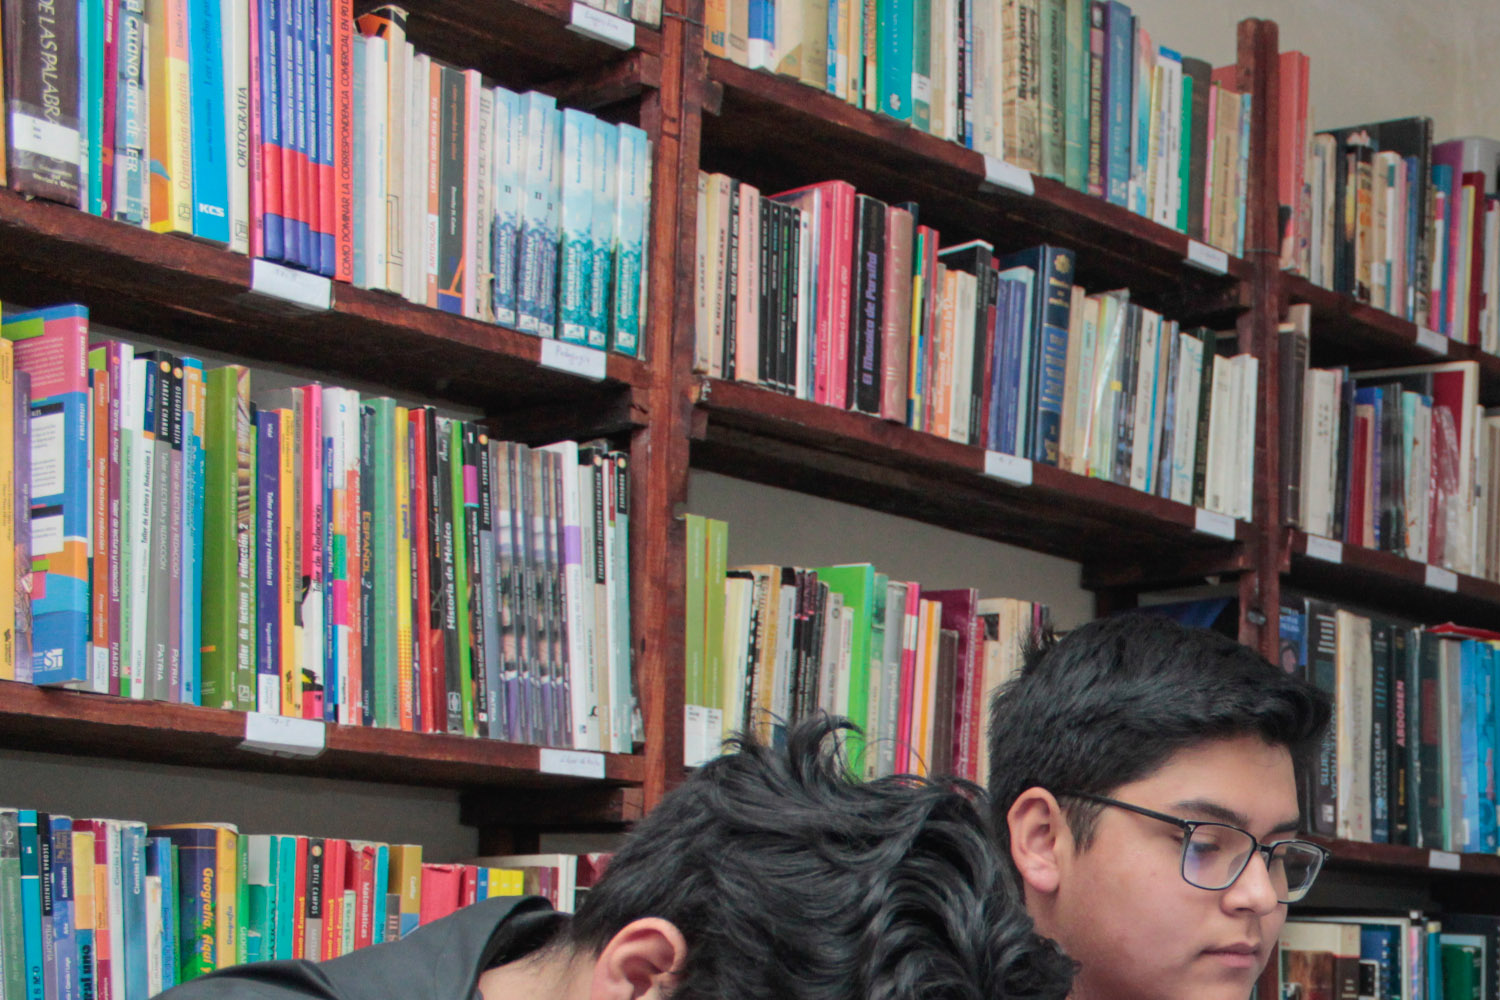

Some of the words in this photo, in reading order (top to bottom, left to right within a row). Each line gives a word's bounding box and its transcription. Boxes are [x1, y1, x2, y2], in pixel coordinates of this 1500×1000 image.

[38, 16, 57, 51] LAS
[340, 18, 350, 32] EN
[340, 35, 350, 87] COMERCIAL
[178, 72, 189, 119] educativa
[236, 87, 248, 168] ORTOGRAFÍA
[340, 91, 351, 180] CORRESPONDENCIA
[340, 182, 350, 195] LA
[199, 202, 225, 217] KCS
[340, 197, 351, 242] DOMINAR
[340, 246, 351, 276] COMO
[866, 251, 879, 300] Parsifal
[865, 303, 876, 318] de
[863, 320, 876, 371] Mosaico
[863, 373, 873, 386] El
[174, 424, 182, 444] MEJÍA
[481, 451, 489, 486] MENCHACA
[266, 492, 274, 509] Taller
[266, 510, 273, 518] de
[239, 533, 250, 578] redacción
[362, 511, 372, 576] ESPAÑOL
[443, 522, 453, 564] México
[445, 567, 455, 580] de
[239, 592, 249, 624] lectura
[446, 582, 457, 629] Historia
[239, 627, 249, 640] de
[157, 643, 165, 681] PATRIA
[171, 648, 179, 686] PATRIA
[238, 644, 249, 670] Taller
[1396, 680, 1405, 747] ABDOMEN
[5, 832, 14, 845] 2
[312, 864, 320, 885] ORTIZ
[362, 859, 371, 871] 2
[201, 867, 214, 930] Geografía.
[311, 887, 319, 915] CAMPOS
[360, 882, 371, 938] Matemáticas
[80, 944, 92, 974] uno
[201, 934, 213, 963] Aquí
